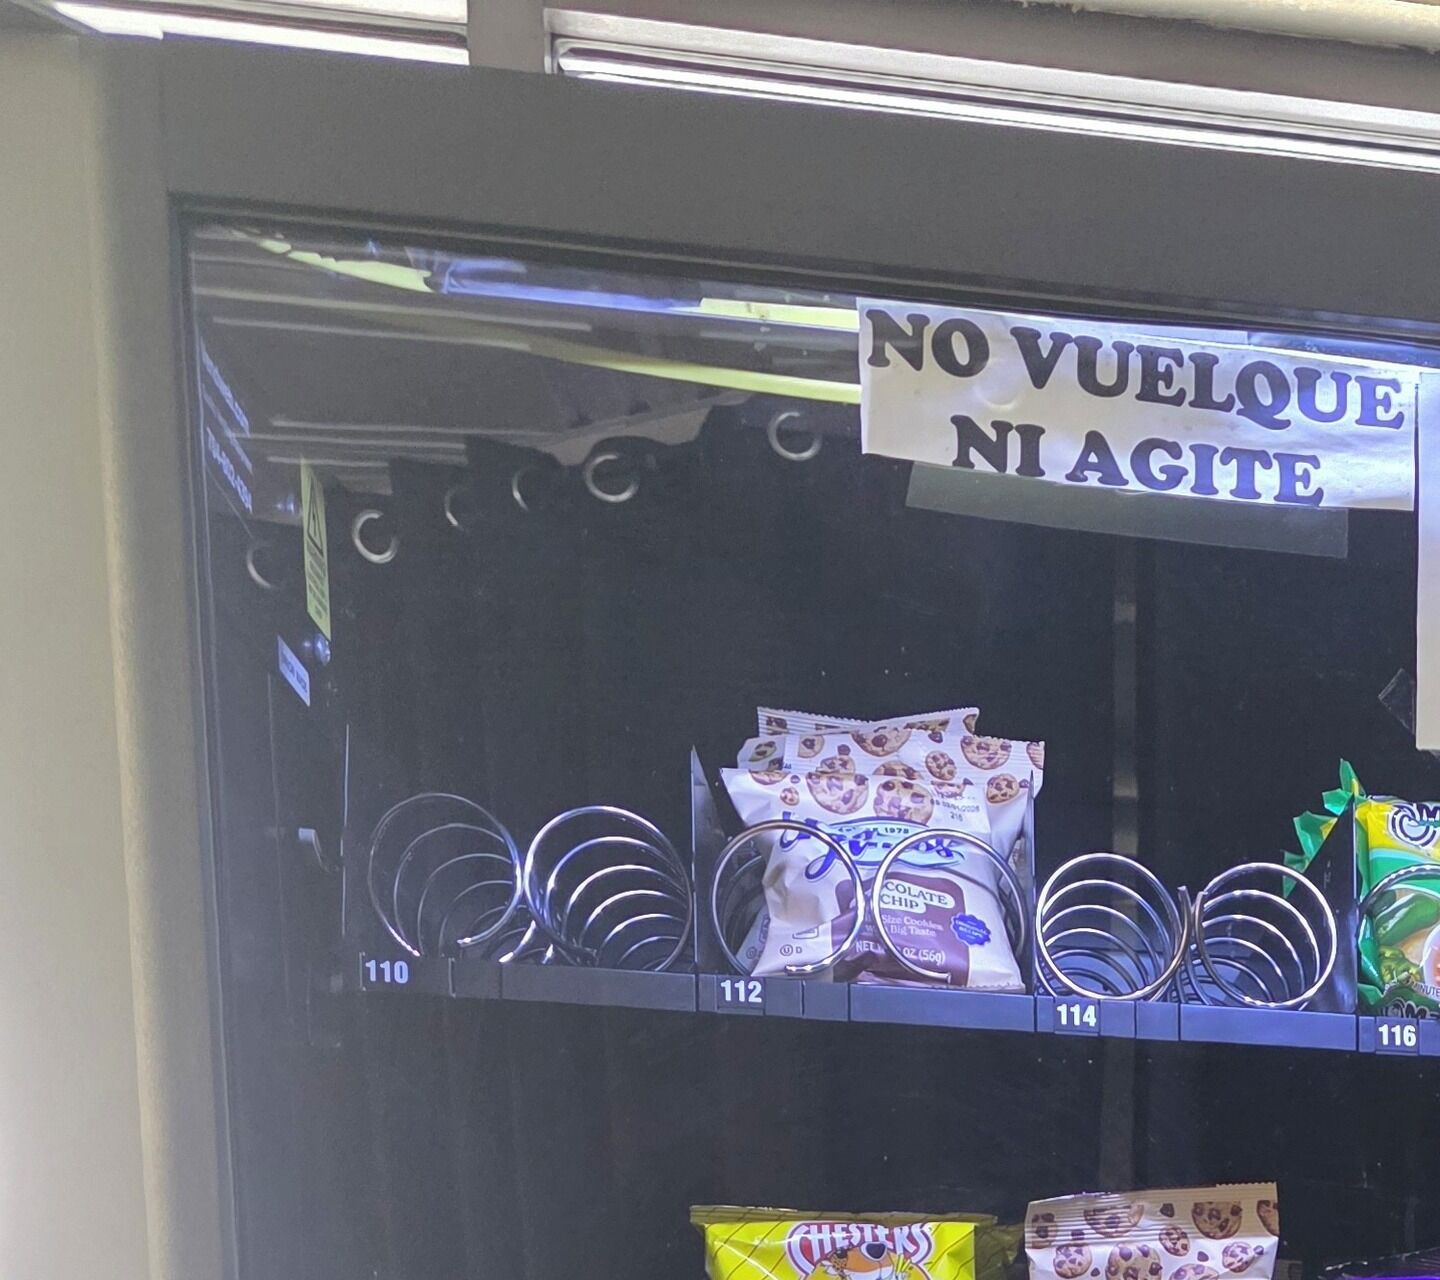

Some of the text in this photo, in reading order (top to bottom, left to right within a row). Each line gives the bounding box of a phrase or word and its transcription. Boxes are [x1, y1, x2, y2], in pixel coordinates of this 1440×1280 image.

[866, 308, 1405, 431] NO VUELQUE
[949, 414, 1325, 507] NI AGITE
[365, 959, 409, 984] 110
[720, 979, 763, 1003] 112
[1056, 1003, 1097, 1028] 114
[1377, 1023, 1418, 1048] 116
